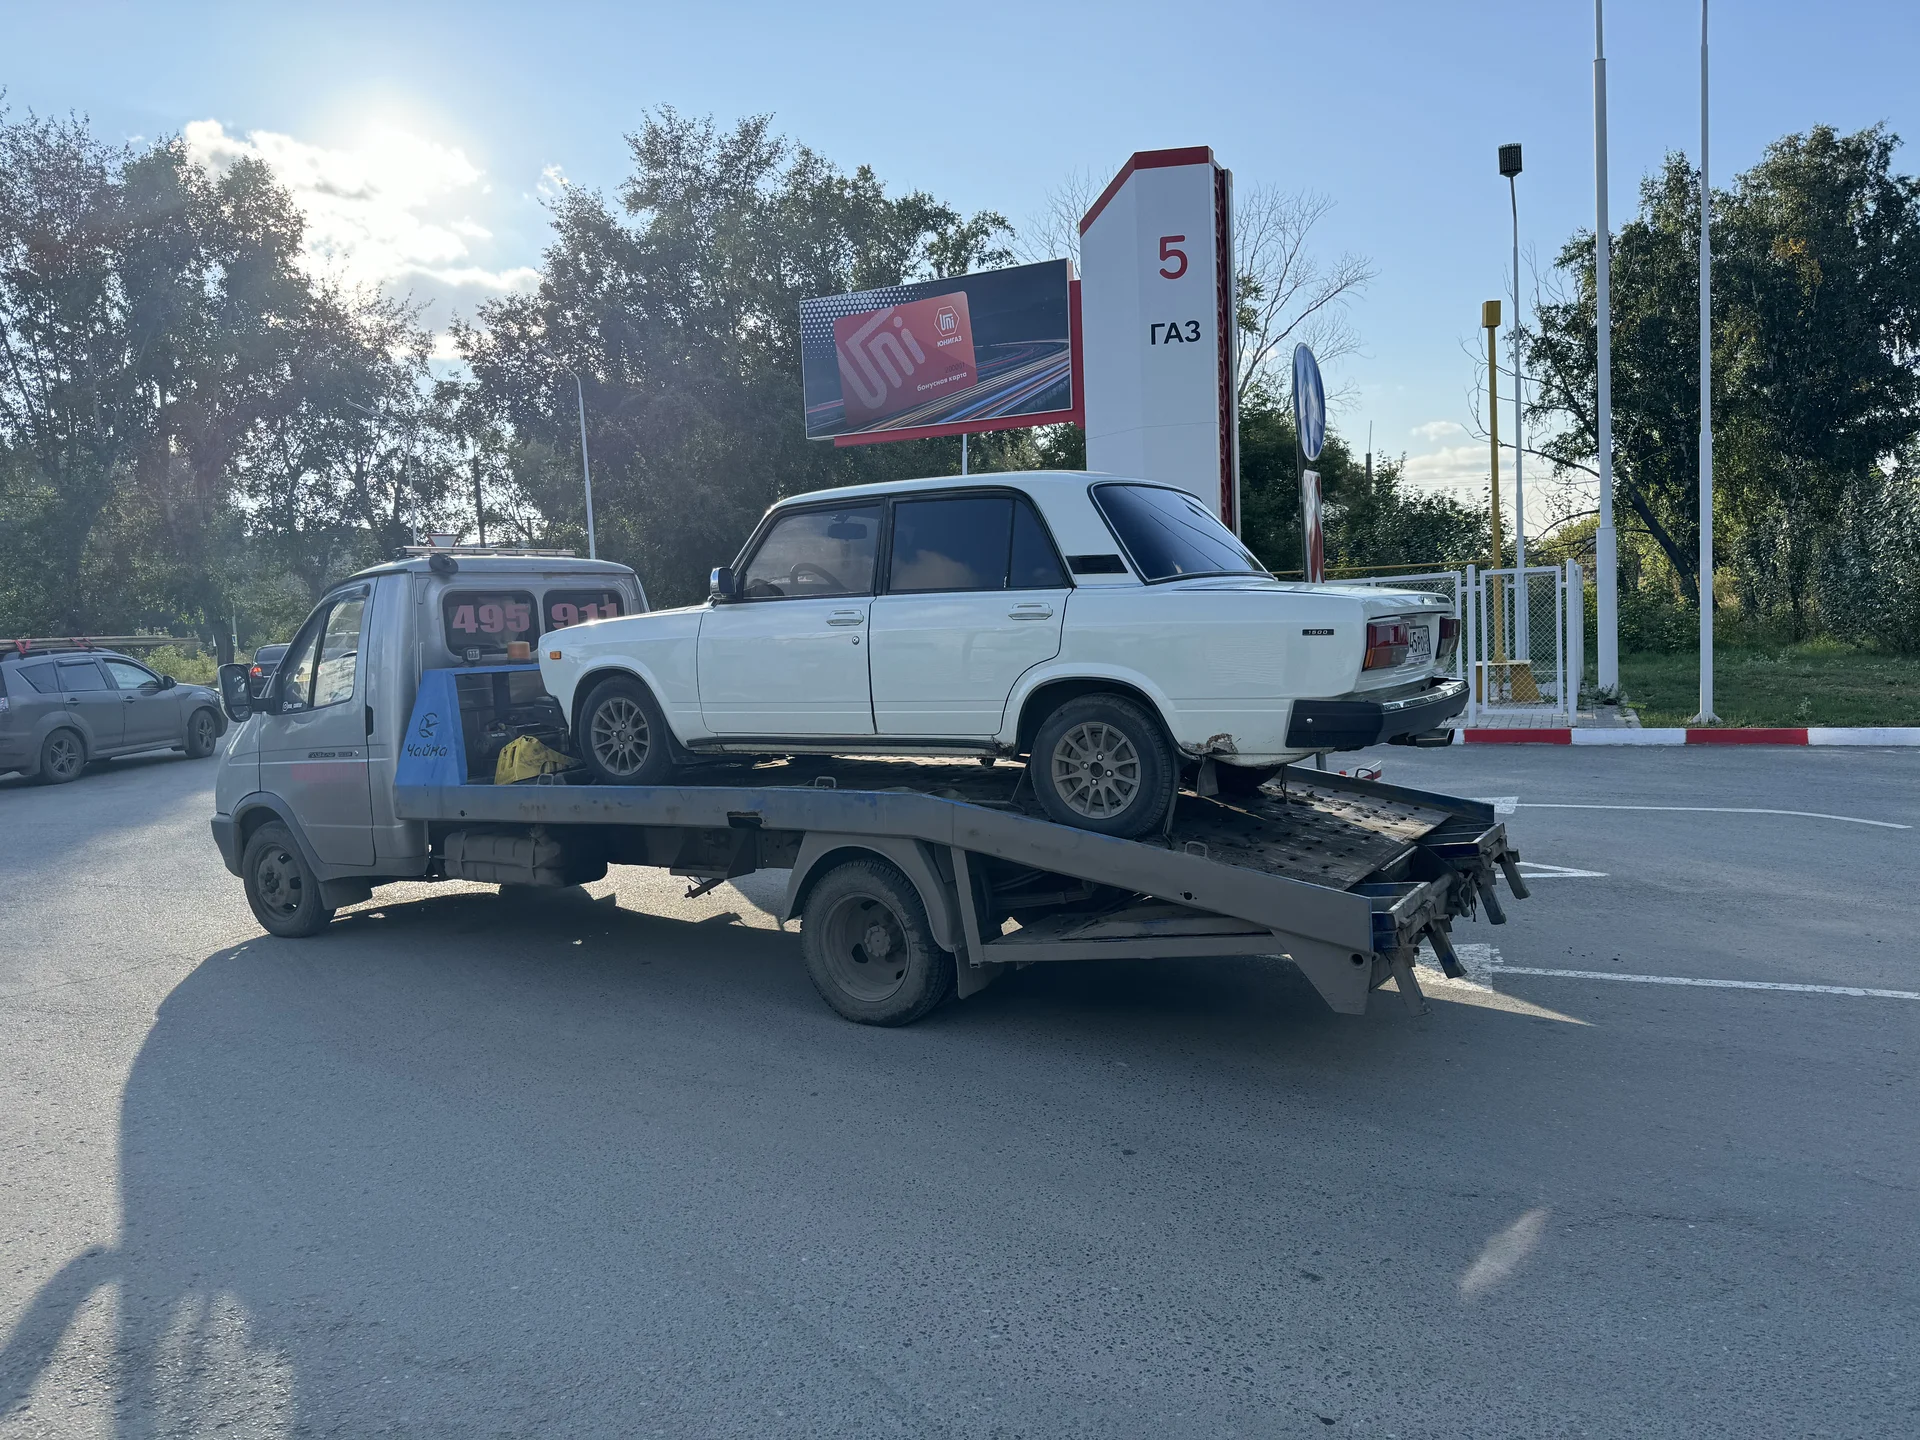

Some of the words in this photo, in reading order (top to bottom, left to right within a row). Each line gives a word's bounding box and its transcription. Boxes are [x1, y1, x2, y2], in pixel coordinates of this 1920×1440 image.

[1159, 234, 1188, 280] 5
[937, 335, 962, 347] ЮНИГАЗ
[1150, 320, 1201, 346] ГАЗ
[916, 377, 948, 392] бонусная
[948, 371, 968, 382] карта
[452, 603, 530, 633] 495
[407, 743, 448, 757] Чайка
